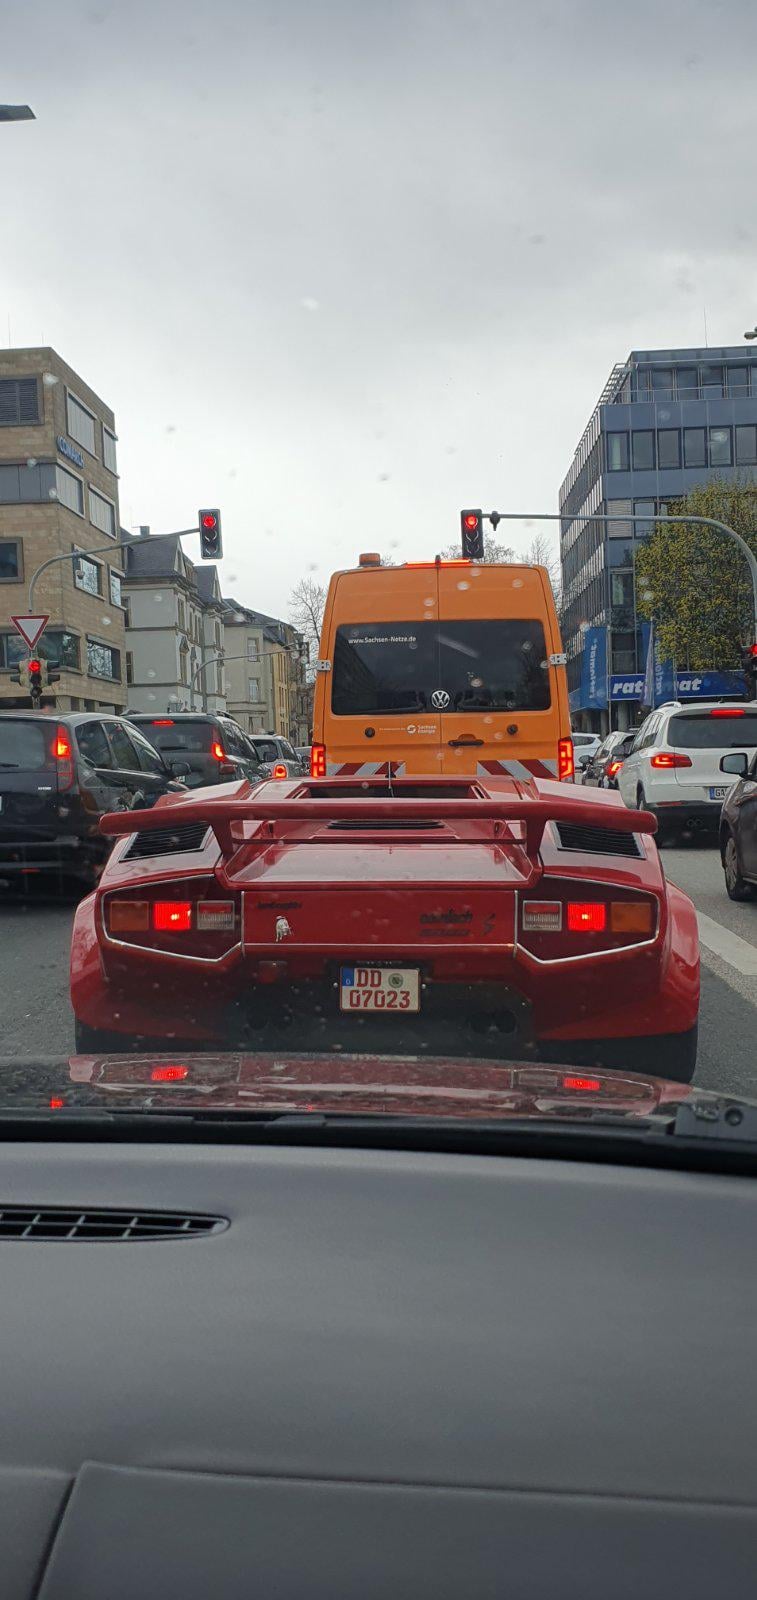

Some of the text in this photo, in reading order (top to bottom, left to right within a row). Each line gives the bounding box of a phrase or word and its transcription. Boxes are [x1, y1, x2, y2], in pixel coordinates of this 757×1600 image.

[348, 636, 416, 644] www.Sachsen-Netze.de
[357, 969, 382, 988] DD
[349, 990, 411, 1009] 07023
